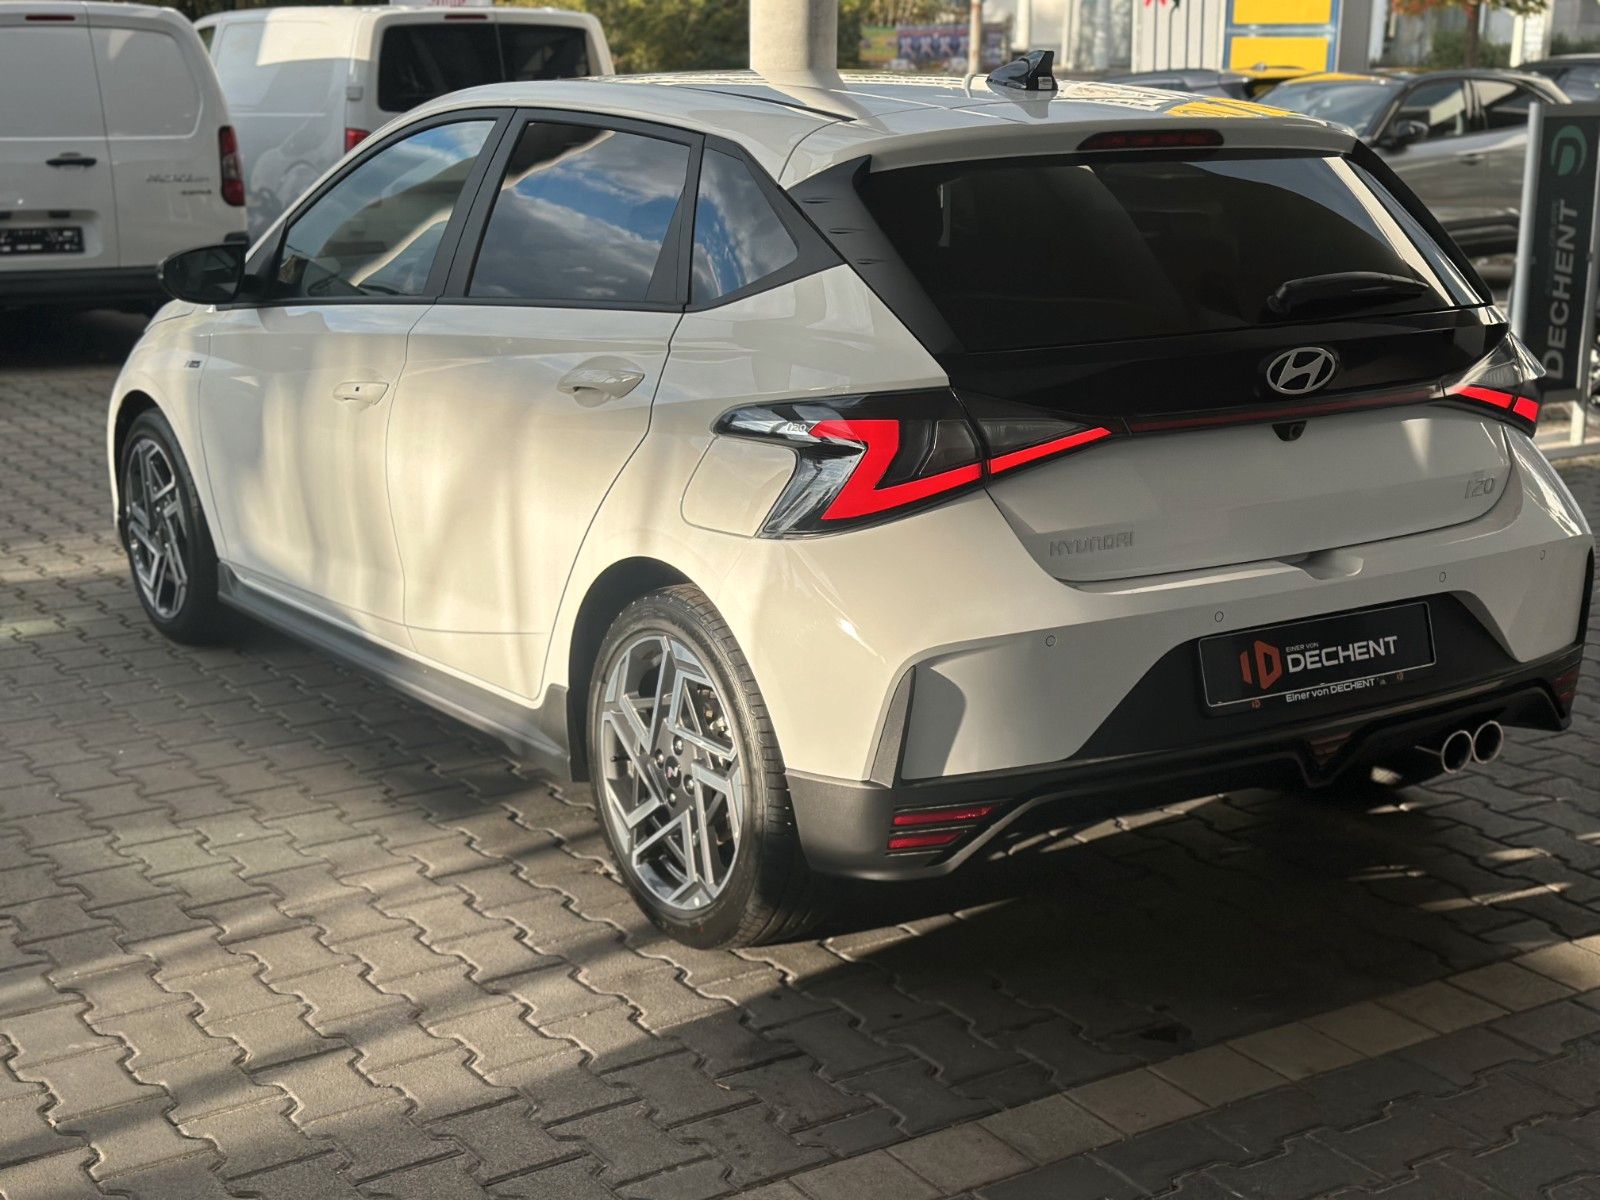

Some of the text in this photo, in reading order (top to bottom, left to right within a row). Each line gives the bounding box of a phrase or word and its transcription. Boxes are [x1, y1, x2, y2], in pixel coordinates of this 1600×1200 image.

[1543, 198, 1578, 379] DECHENT
[1049, 530, 1134, 557] HYUNDAI
[1285, 642, 1320, 653] EINER VON
[1286, 635, 1398, 673] DECHENT
[1285, 678, 1376, 703] Einer von DECHENT
